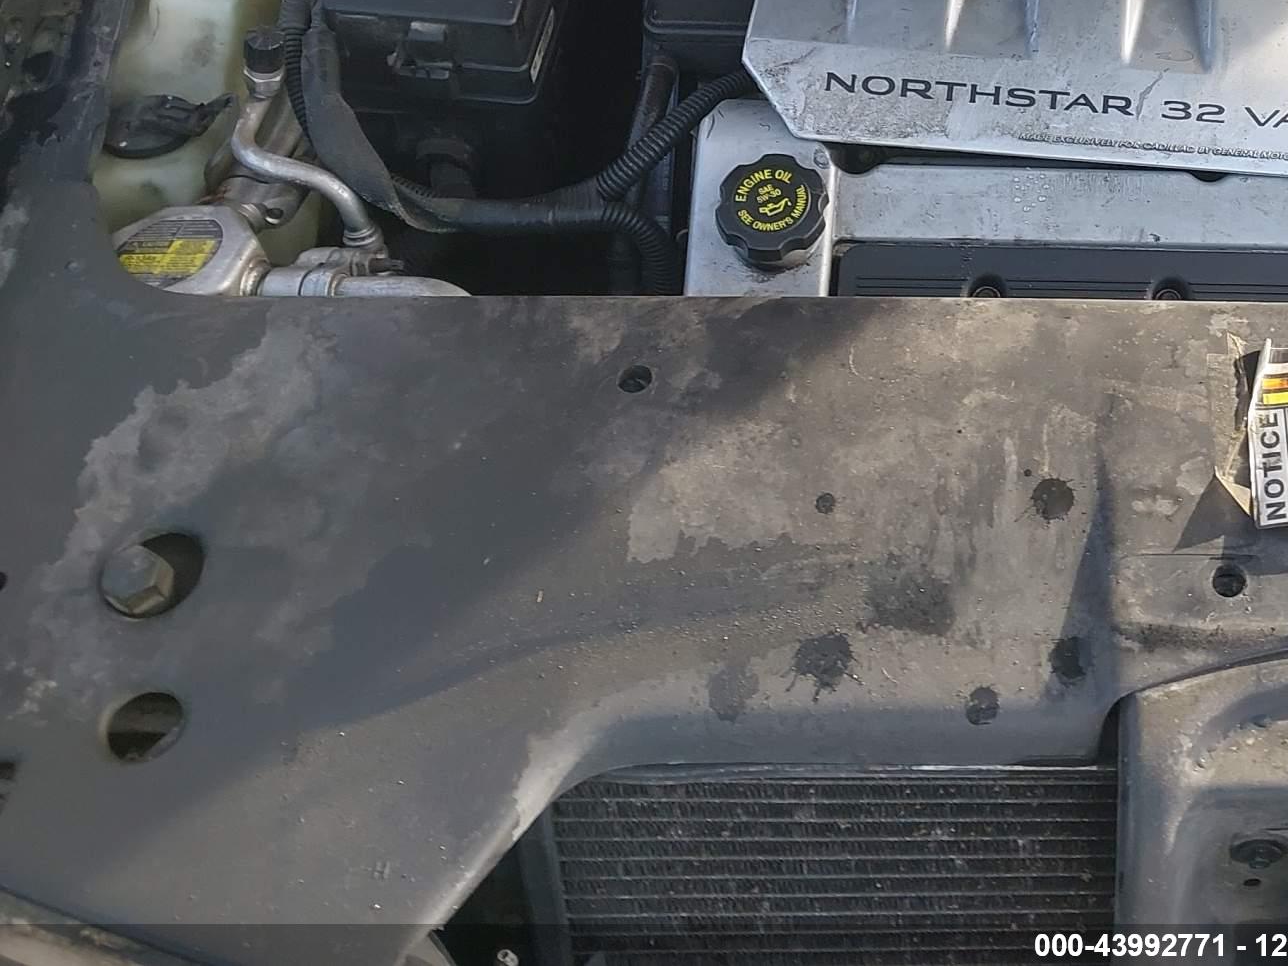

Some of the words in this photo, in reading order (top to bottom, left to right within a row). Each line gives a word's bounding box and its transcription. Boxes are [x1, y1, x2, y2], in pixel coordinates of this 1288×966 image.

[824, 72, 1134, 116] NORTHSTAR
[1161, 101, 1225, 124] 32
[1052, 134, 1118, 147] EXCLUSIVELY
[1119, 140, 1141, 149] FOR
[1142, 142, 1195, 153] CADILLAC
[1197, 146, 1211, 154] BY
[1212, 147, 1259, 158] GENERAL
[735, 169, 772, 202] ENGINE
[775, 169, 792, 184] OIL
[756, 188, 781, 203] 5W-30
[758, 184, 774, 195] SAE
[738, 209, 754, 225] SEE
[752, 216, 794, 231] OWNER'S
[791, 184, 807, 218] MANUAL
[1260, 413, 1287, 521] NOTICE
